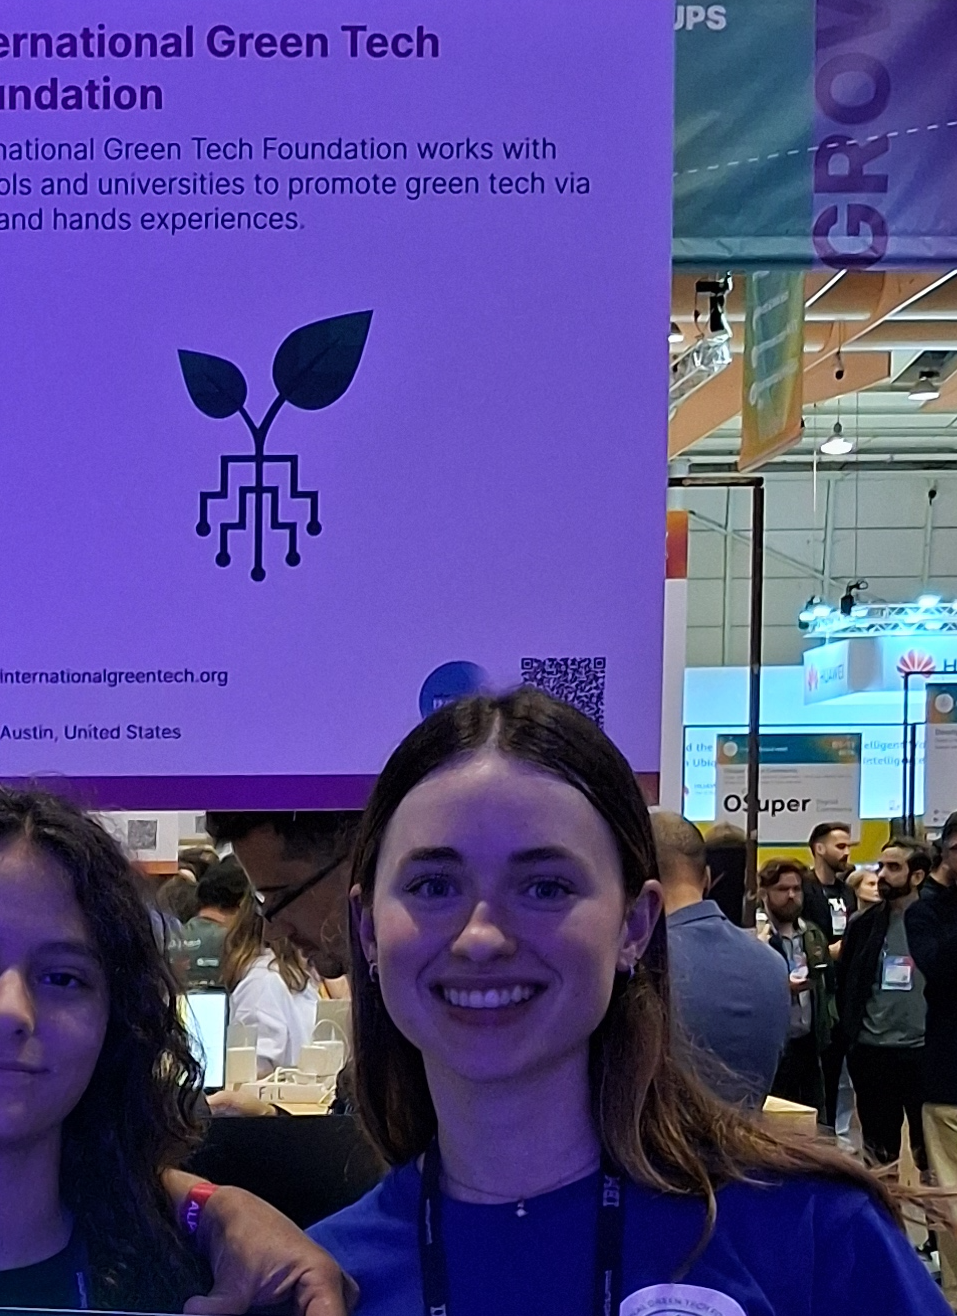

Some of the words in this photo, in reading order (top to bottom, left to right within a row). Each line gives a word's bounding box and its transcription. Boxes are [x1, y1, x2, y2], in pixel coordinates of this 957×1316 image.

[207, 25, 330, 60] Green
[341, 25, 440, 60] Tech
[104, 138, 182, 162] Green
[192, 137, 254, 161] Tech
[264, 137, 408, 161] Foundation
[418, 137, 495, 161] works
[503, 137, 558, 161] with
[41, 173, 89, 197] and
[99, 173, 246, 197] universities
[255, 174, 280, 197] to
[288, 176, 398, 202] promote
[405, 177, 480, 202] green
[489, 172, 546, 196] tech
[554, 172, 591, 196] via
[54, 208, 133, 232] hands
[141, 207, 307, 237] experiences.
[0, 668, 229, 689] internationalgreentech.org
[0, 725, 59, 743] Austin,
[65, 725, 121, 741] United
[127, 725, 182, 741] States
